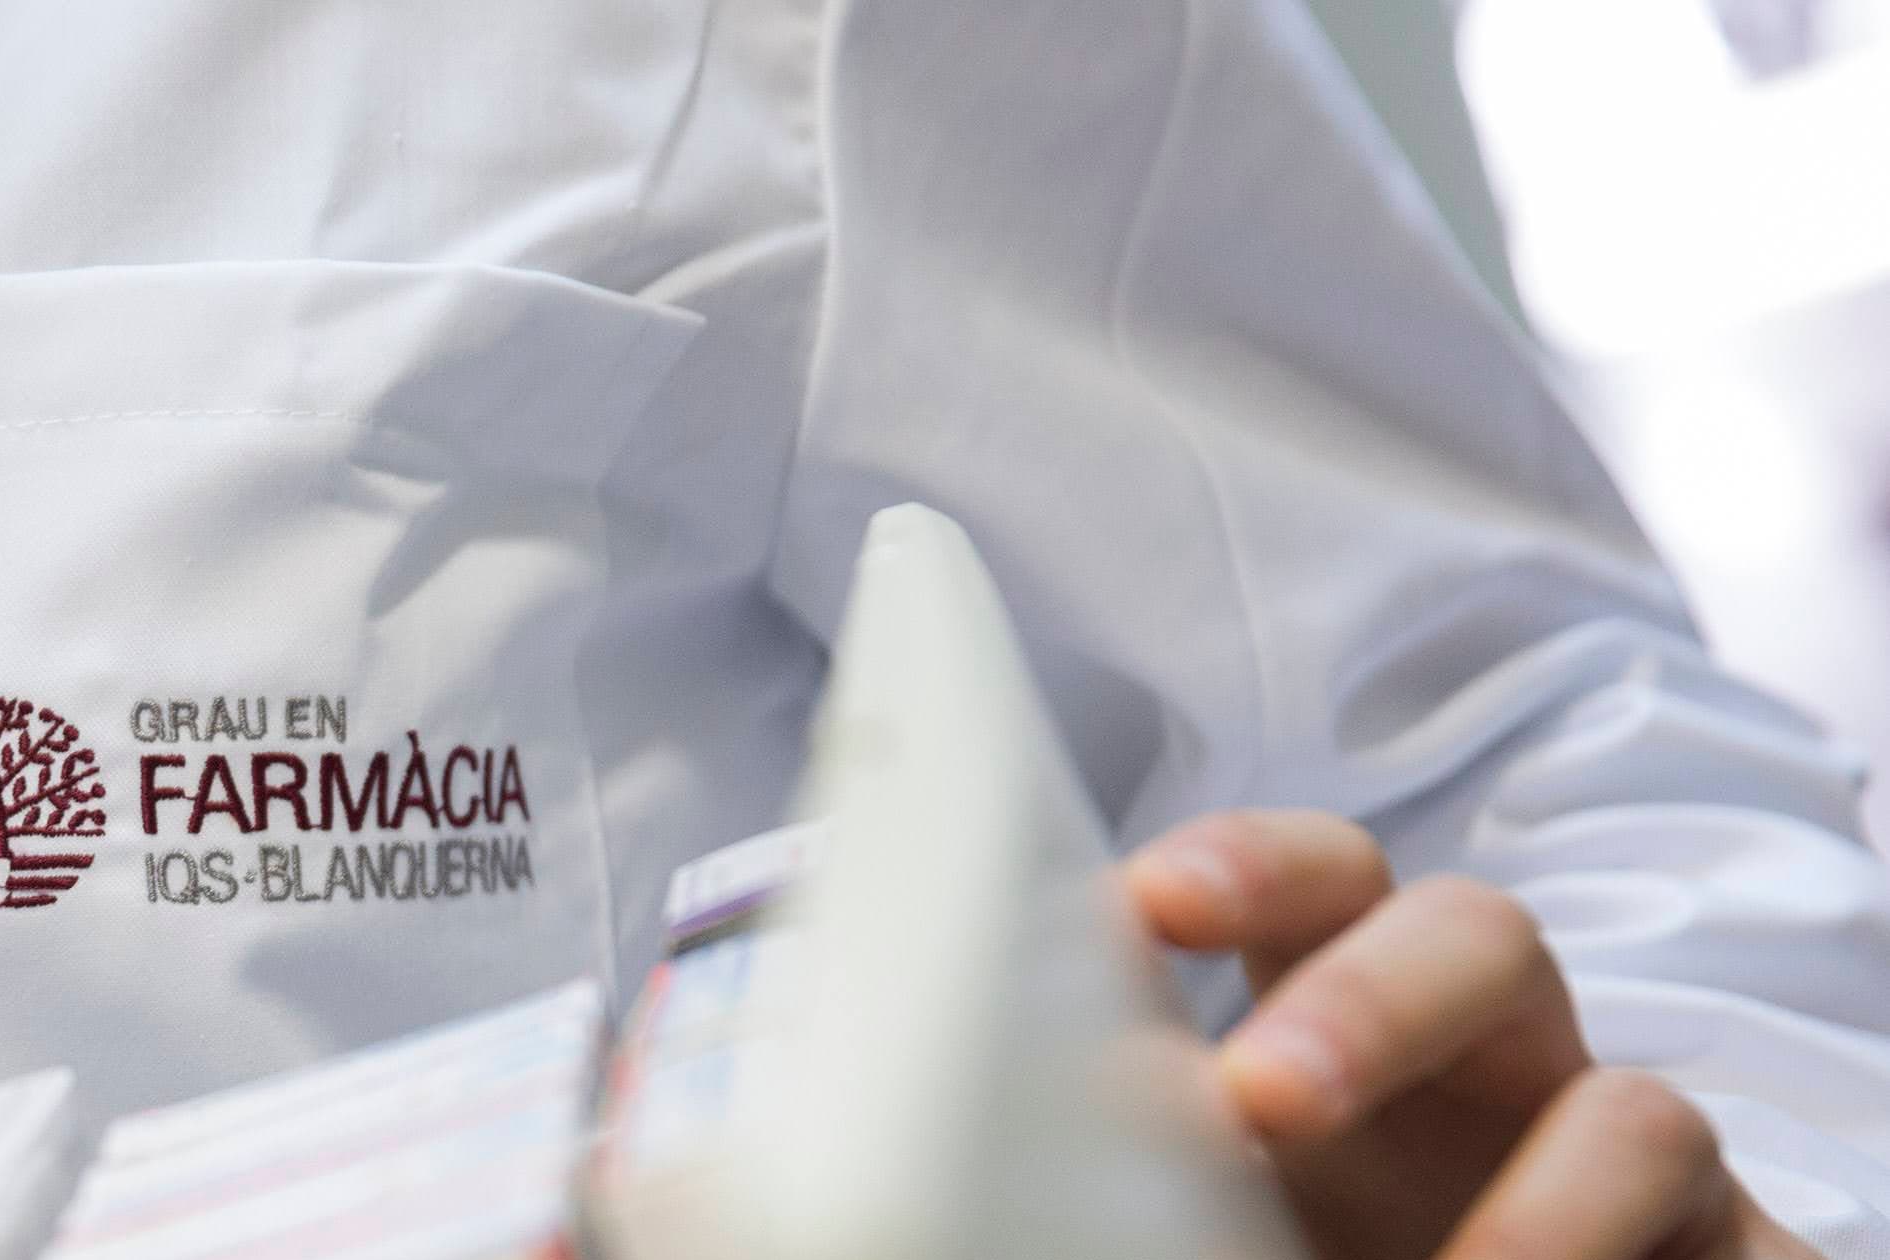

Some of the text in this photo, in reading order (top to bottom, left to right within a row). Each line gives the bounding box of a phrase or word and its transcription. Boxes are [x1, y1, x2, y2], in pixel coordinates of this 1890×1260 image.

[130, 696, 347, 743] GRAU EN
[139, 730, 531, 834] FARMÀCIA
